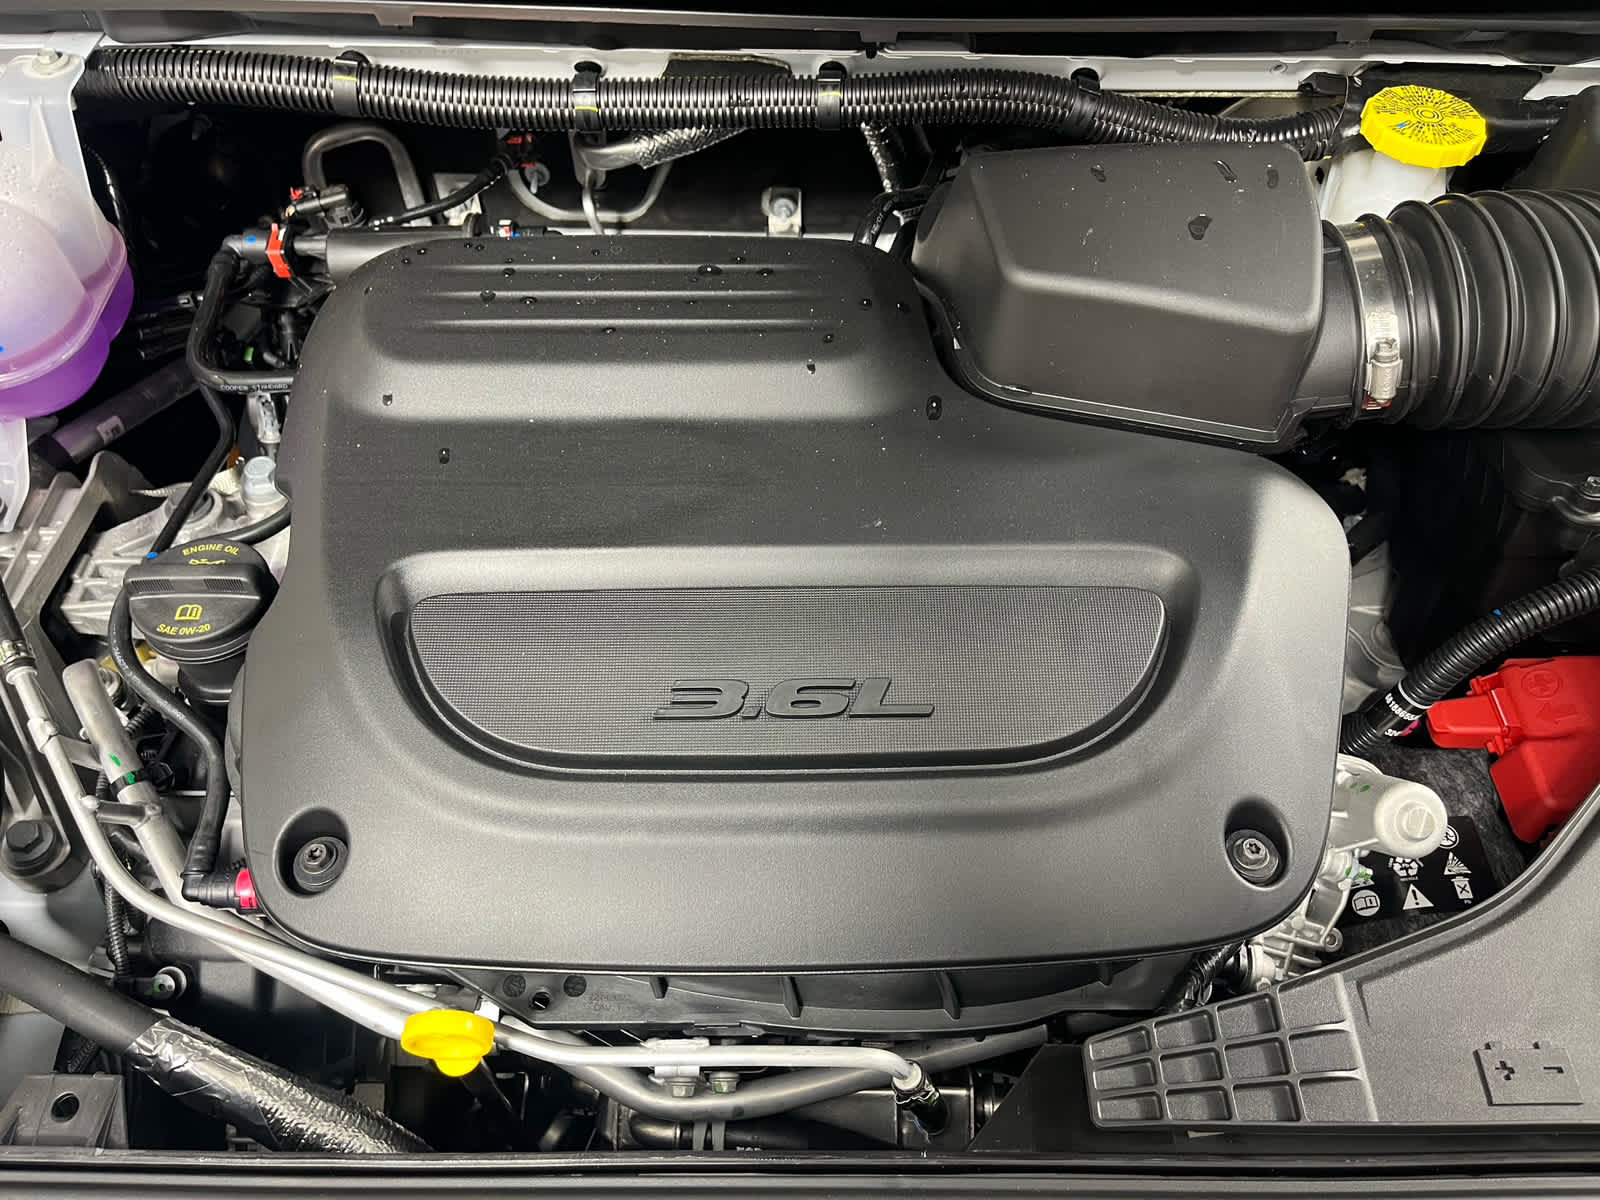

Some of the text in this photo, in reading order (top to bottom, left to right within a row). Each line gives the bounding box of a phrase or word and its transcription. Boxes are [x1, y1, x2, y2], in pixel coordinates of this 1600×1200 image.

[182, 543, 240, 556] ENGINE OIL
[156, 623, 211, 636] SAE 0W-20
[653, 677, 935, 720] 3.6L
